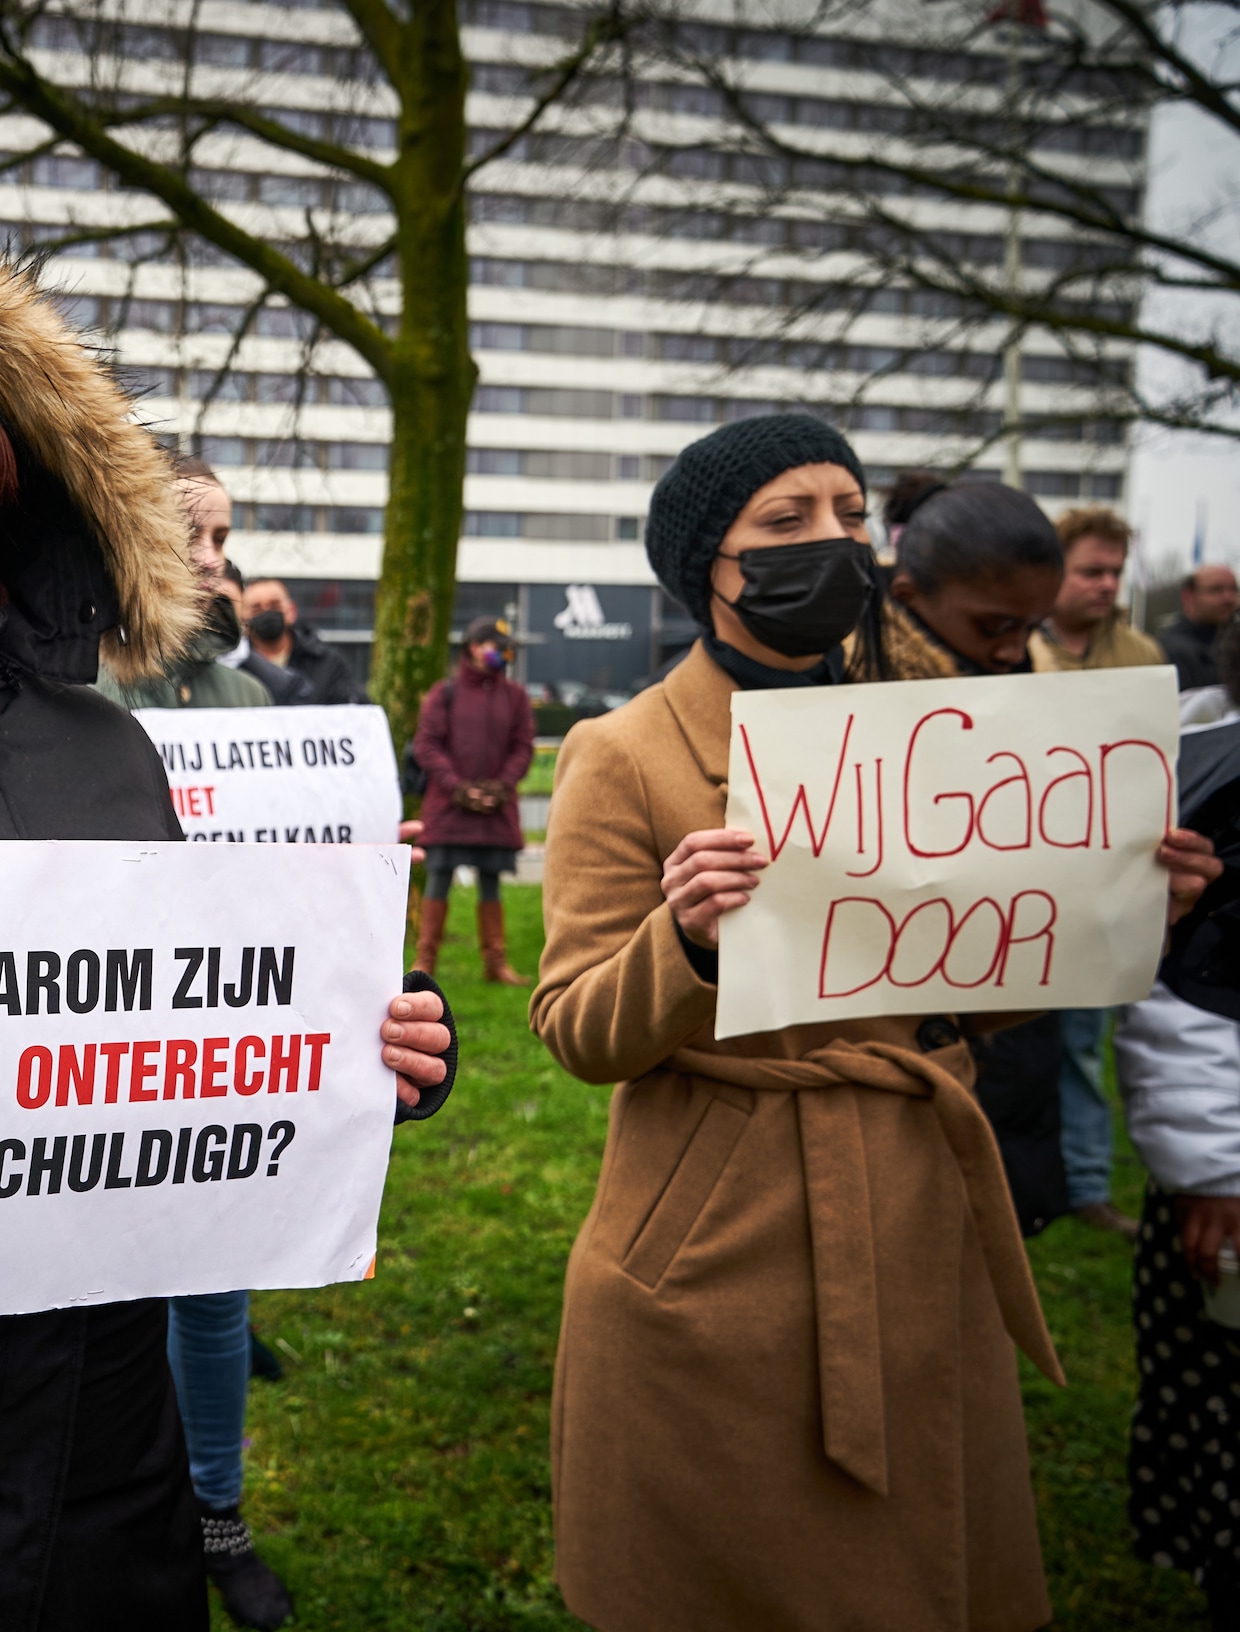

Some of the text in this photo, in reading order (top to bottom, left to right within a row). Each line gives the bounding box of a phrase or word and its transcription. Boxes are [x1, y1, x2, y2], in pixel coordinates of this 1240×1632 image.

[211, 740, 293, 769] LATEN
[303, 738, 355, 767] ONS
[171, 946, 296, 1010] ZIJN
[818, 889, 1058, 1000] DOOR
[15, 1032, 332, 1111] ONTERECHT
